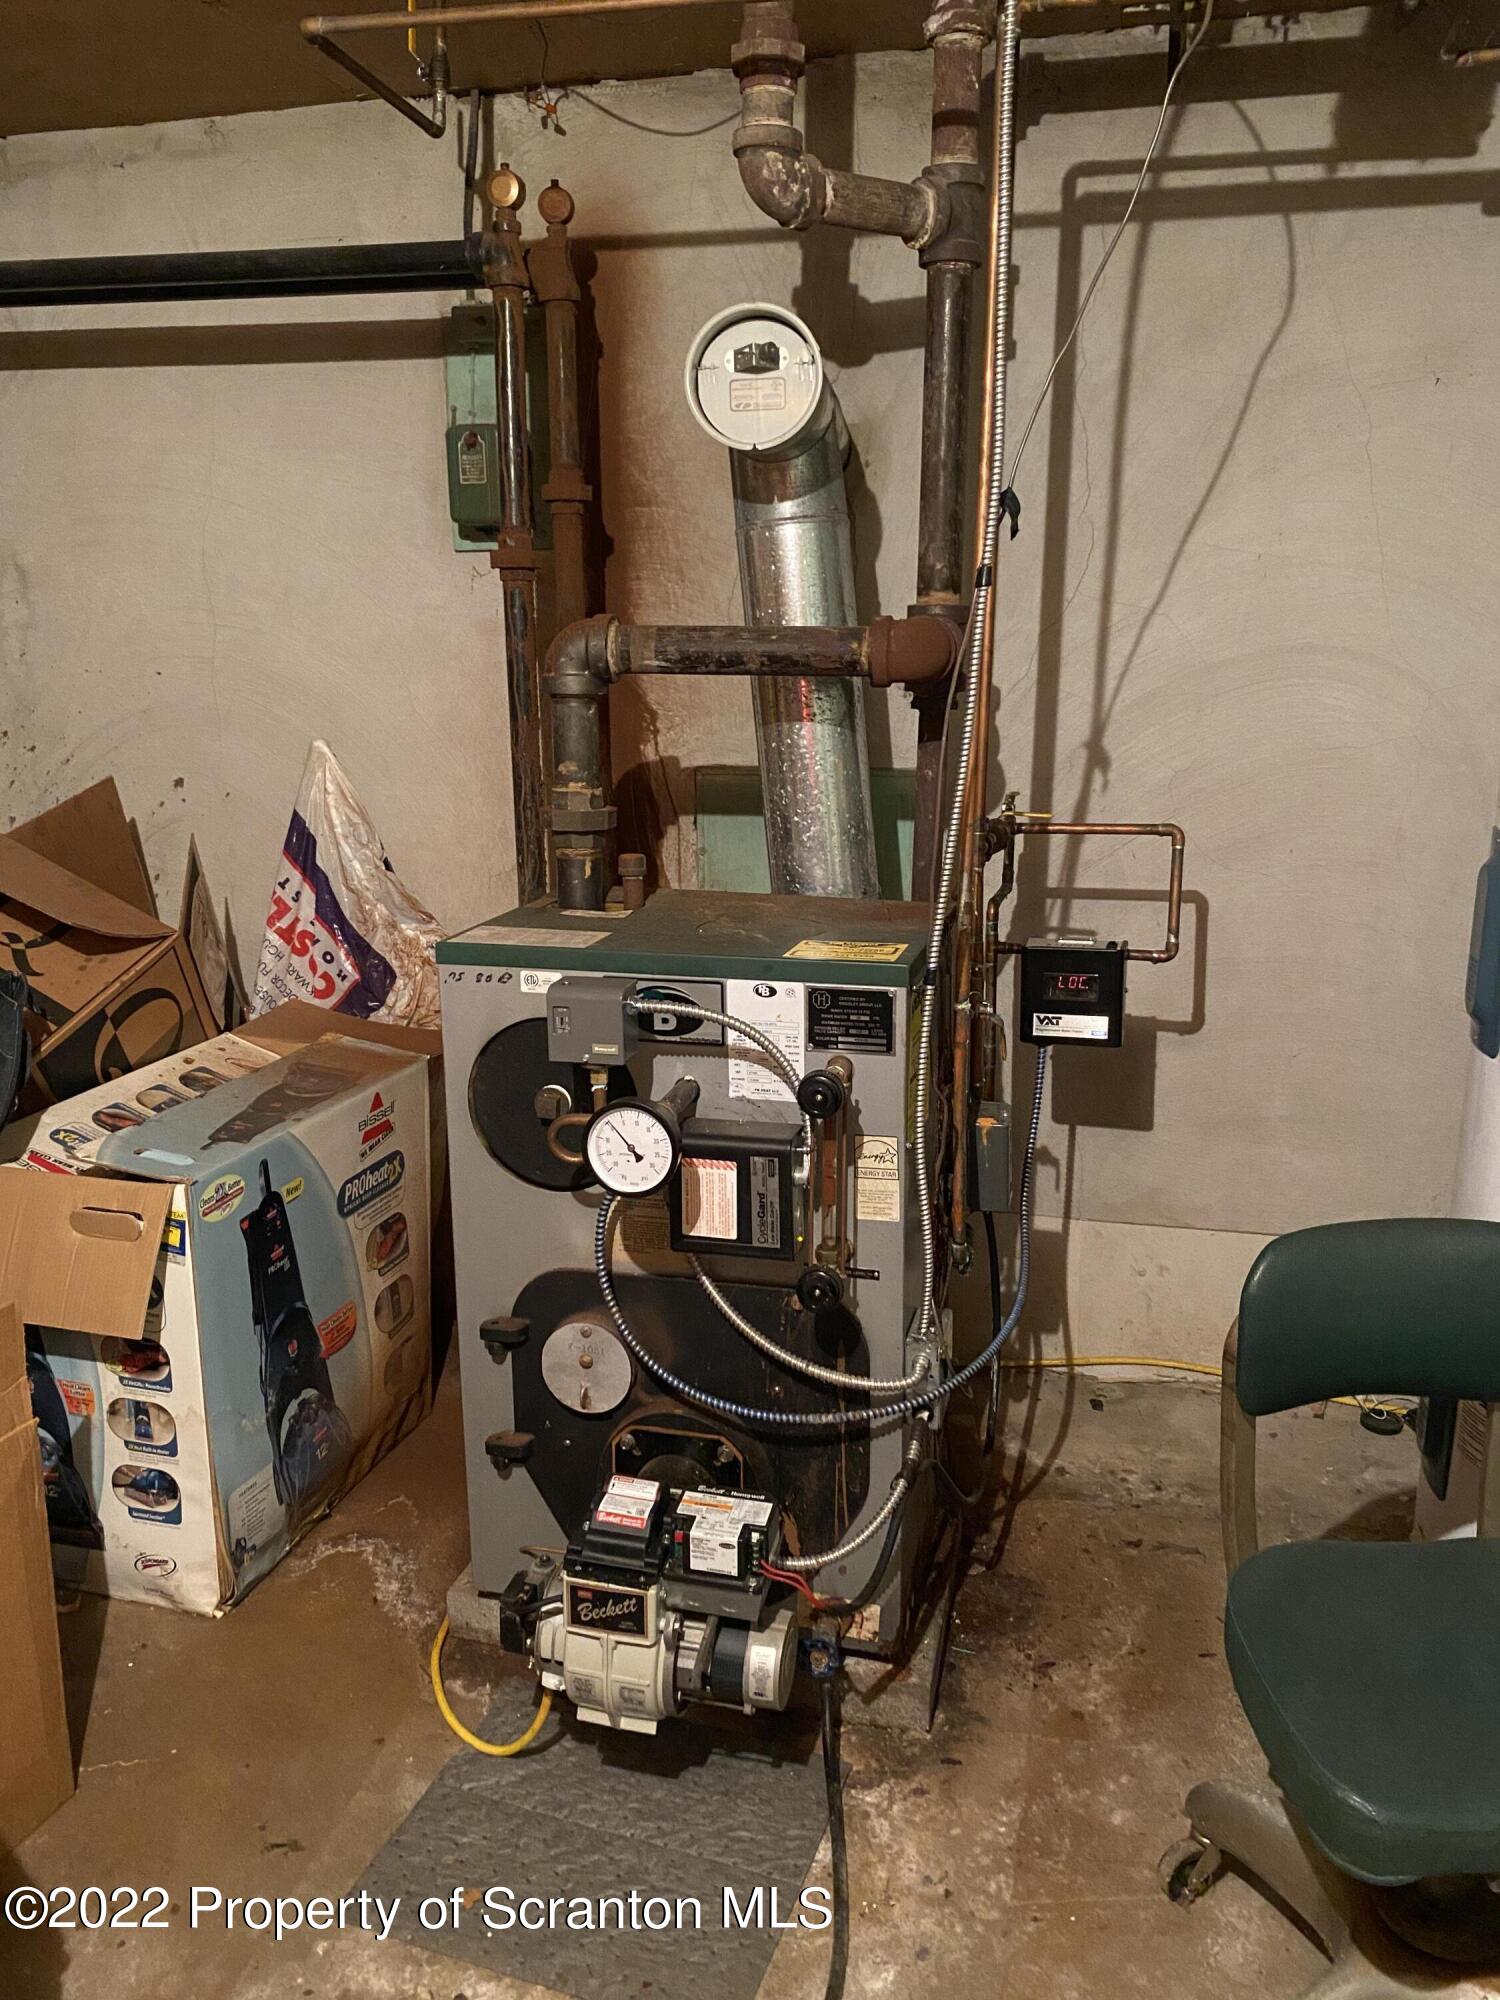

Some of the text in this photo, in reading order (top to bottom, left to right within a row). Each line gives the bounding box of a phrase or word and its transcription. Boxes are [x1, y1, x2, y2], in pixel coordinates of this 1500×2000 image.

[857, 1169, 897, 1178] ENERGY STAR
[285, 1179, 303, 1198] New!
[757, 1191, 766, 1244] CycleGard
[730, 1490, 765, 1500] Honeywell
[577, 1597, 638, 1621] Beckett
